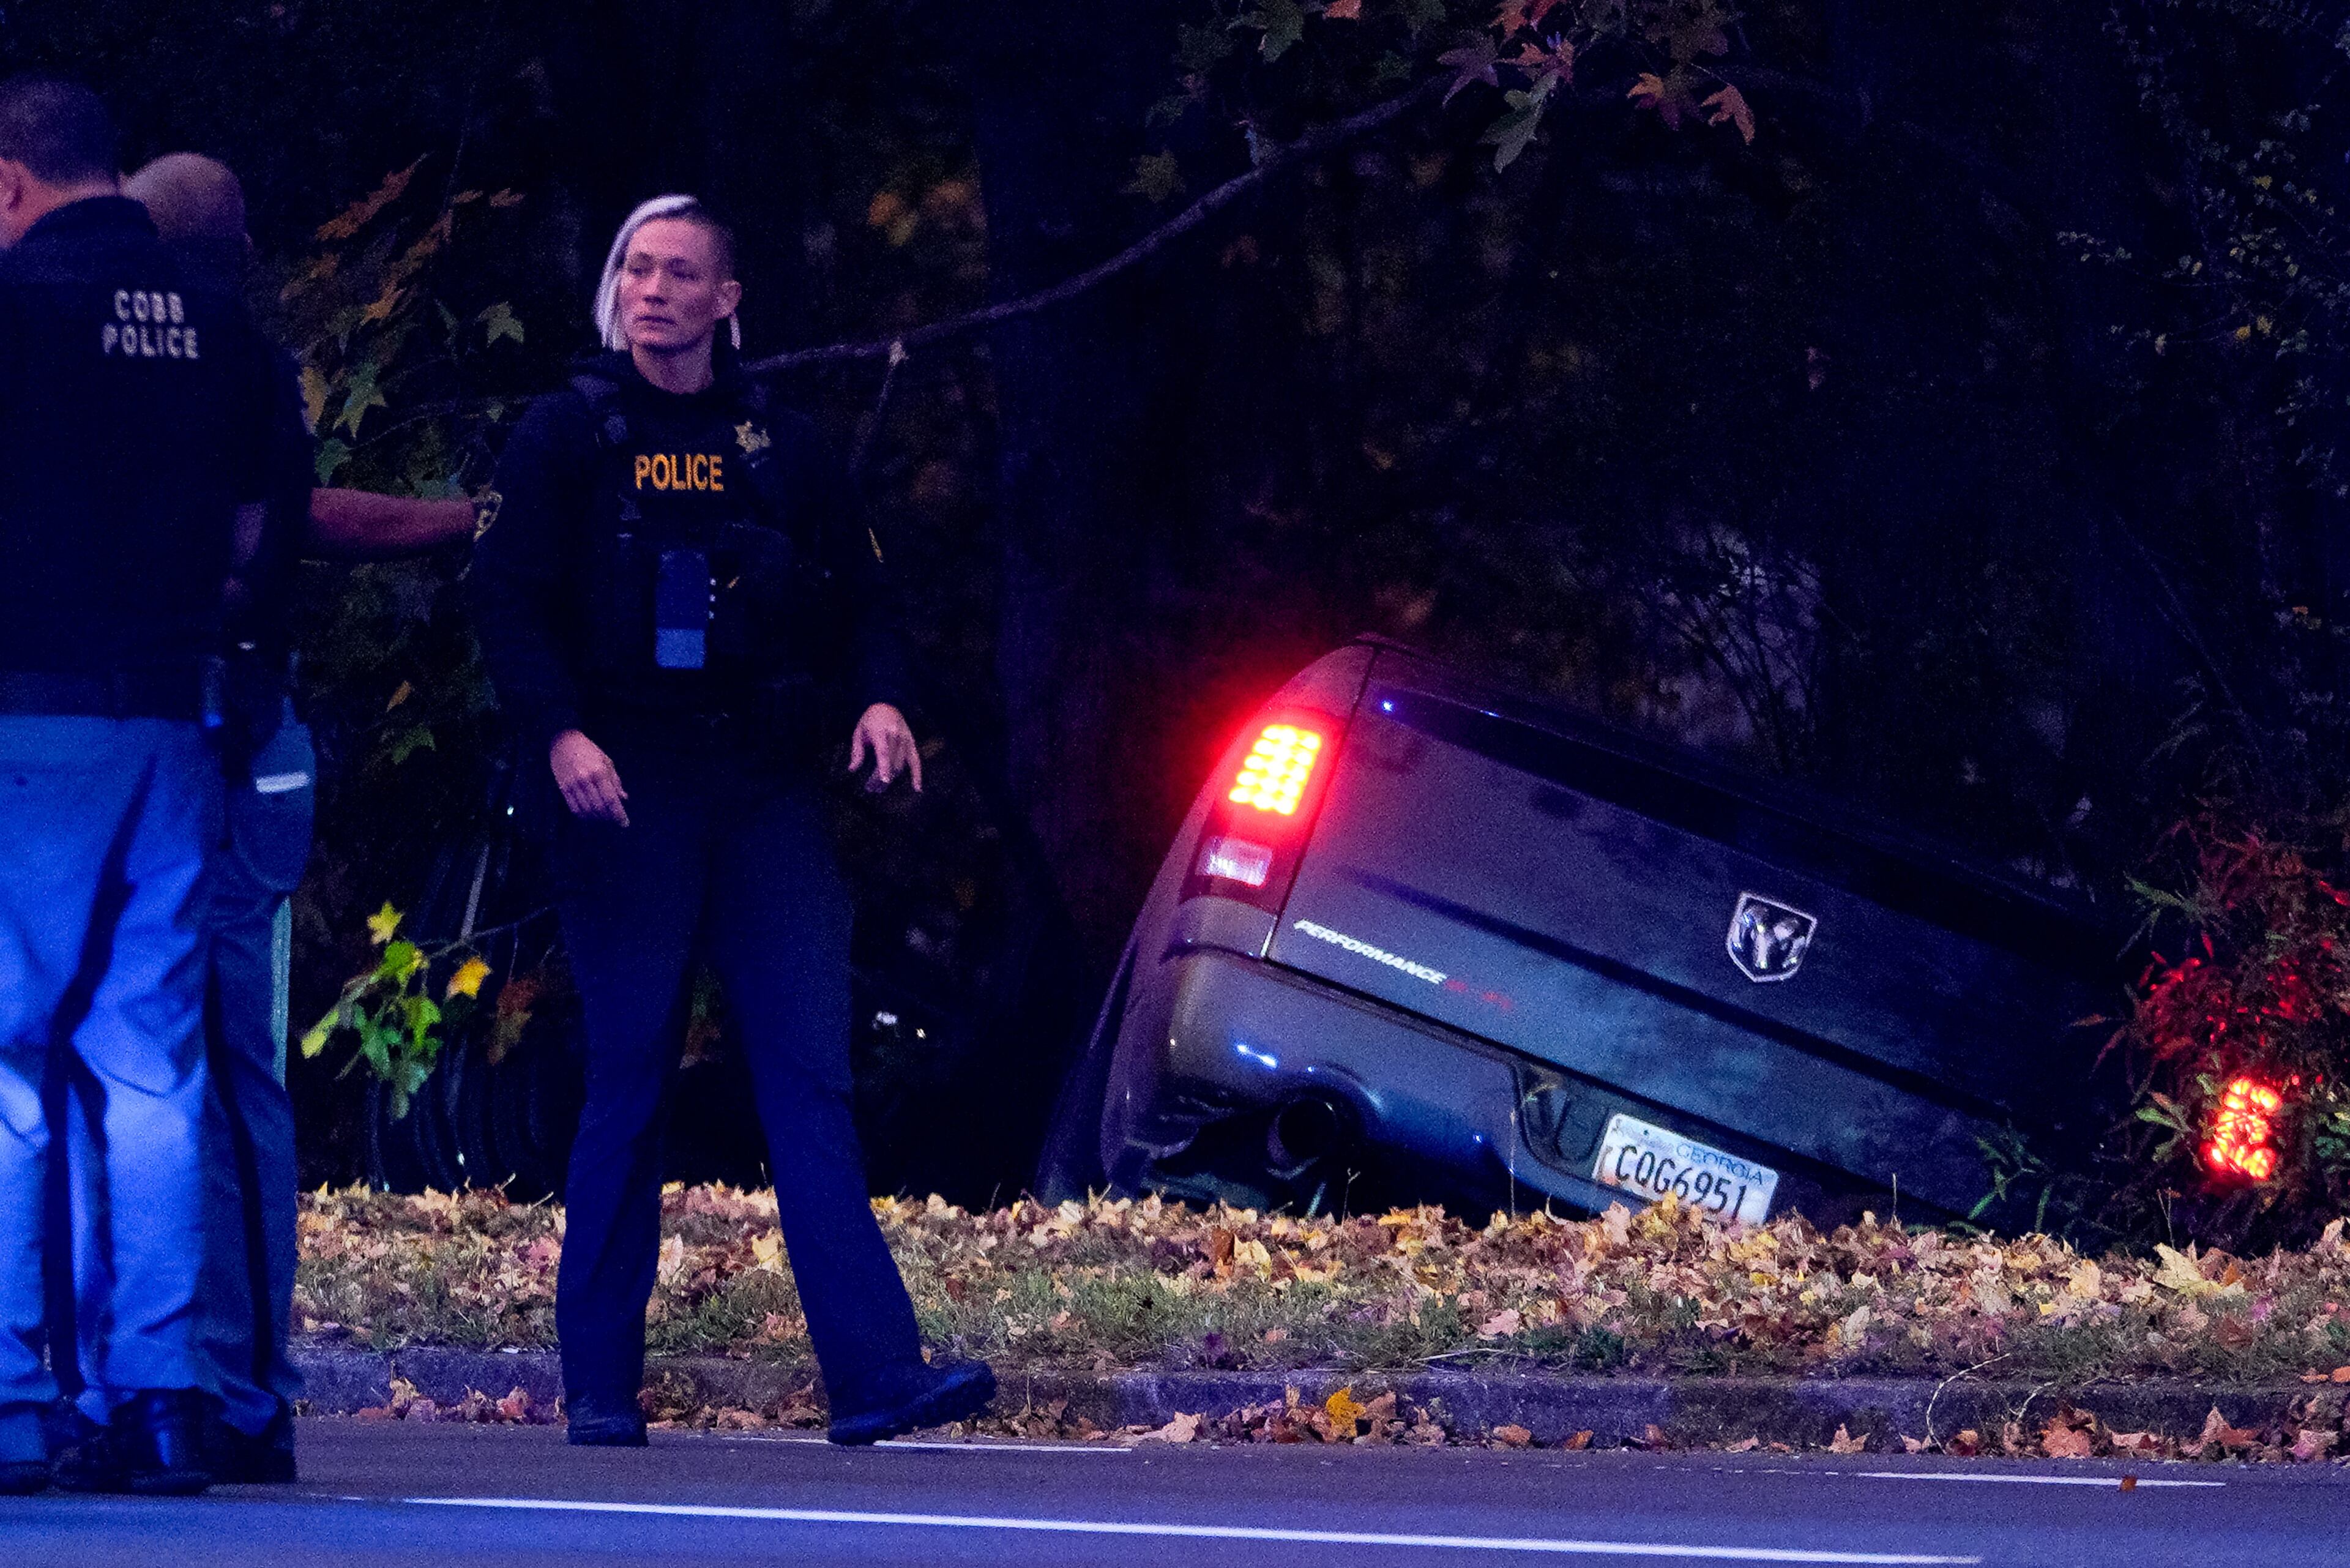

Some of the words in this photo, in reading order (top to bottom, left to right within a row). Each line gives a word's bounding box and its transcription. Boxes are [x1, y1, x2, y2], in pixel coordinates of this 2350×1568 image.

[114, 289, 184, 324] COBB
[102, 323, 200, 359] POLICE
[634, 454, 724, 491] POLICE
[1293, 919, 1447, 985] PERFORMANCE
[1676, 1142, 1763, 1186] GEORGIA
